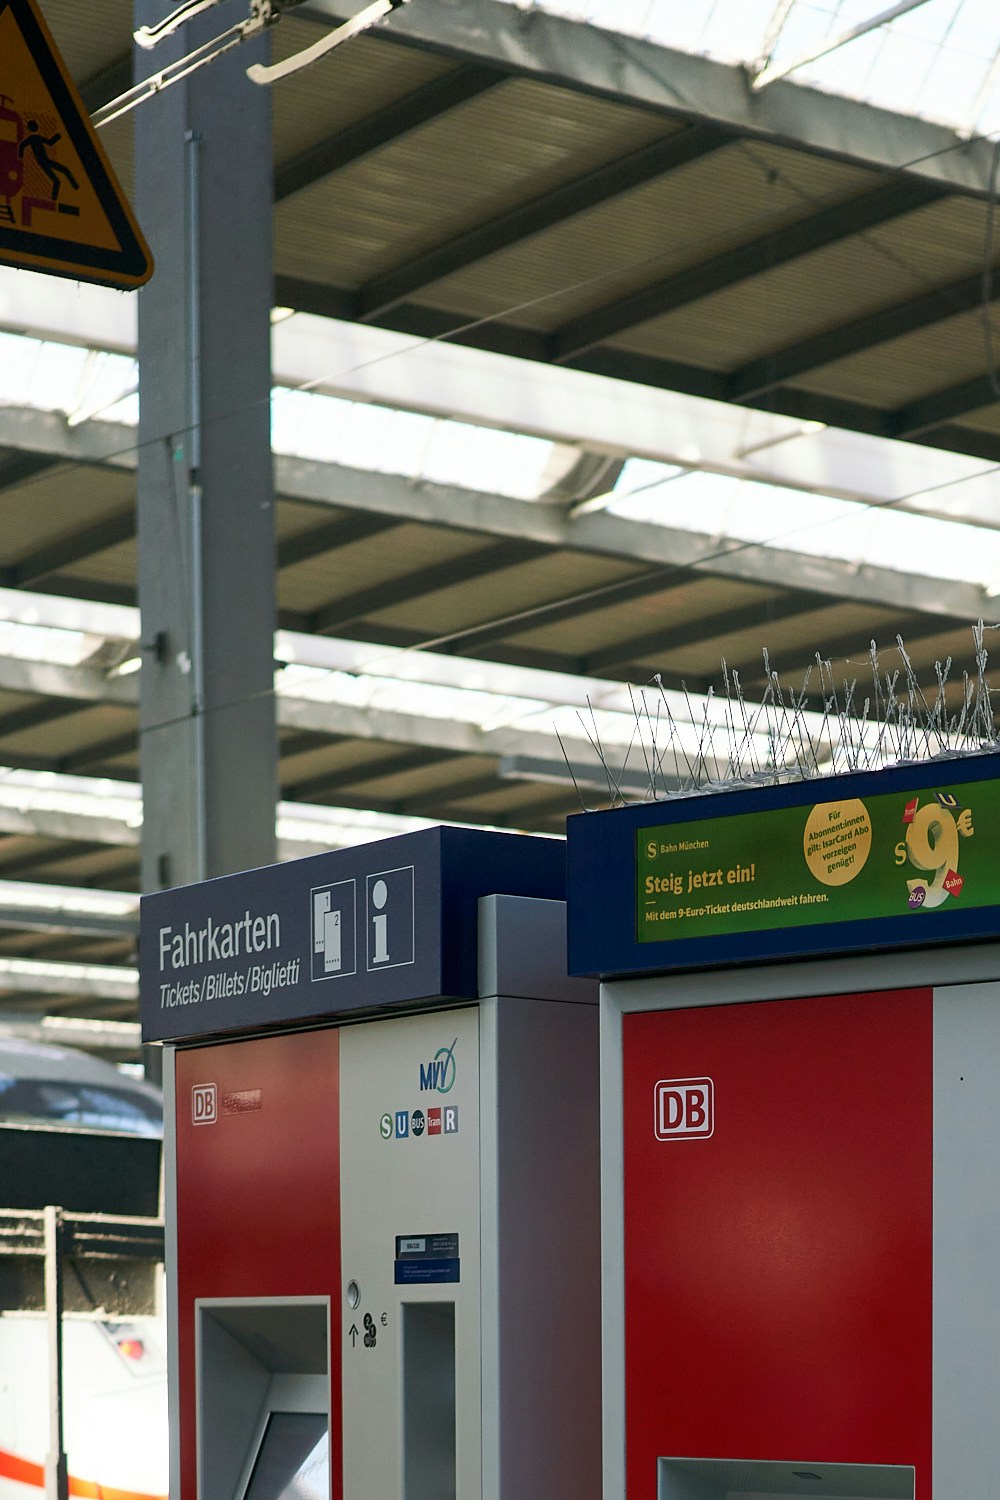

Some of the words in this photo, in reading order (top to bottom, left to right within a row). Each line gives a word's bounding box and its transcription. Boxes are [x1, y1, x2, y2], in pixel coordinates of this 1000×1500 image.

[938, 792, 957, 807] U
[808, 813, 866, 842] Abonnent:innen
[828, 810, 842, 822] Für
[647, 842, 657, 859] S
[660, 843, 678, 854] Bahn
[678, 839, 709, 852] München
[807, 842, 822, 857] gilt:
[822, 832, 853, 851] IsarCard
[854, 825, 869, 839] Abo
[822, 842, 858, 862] vorzeigen
[894, 841, 908, 866] S
[827, 854, 855, 874] genügt!
[905, 802, 959, 909] 9
[956, 808, 975, 837] €
[645, 872, 684, 895] Steig
[688, 868, 724, 893] jetzt
[726, 863, 756, 885] ein!
[945, 876, 963, 889] Bahn
[645, 911, 659, 922] Mit
[660, 909, 677, 920] dem
[678, 904, 731, 919] 9-Euro-Ticket
[731, 895, 798, 912] deutschlandweit
[799, 892, 829, 905] fahren.
[908, 891, 925, 903] BUS
[334, 914, 339, 927] 2
[159, 911, 280, 971] Fahrkarten
[159, 958, 300, 1009] Tickets/Billets/Biglietti
[194, 1088, 215, 1120] DB
[660, 1084, 709, 1134] DB
[381, 1115, 391, 1138] S
[397, 1115, 406, 1135] U
[411, 1117, 424, 1129] BUS
[427, 1116, 441, 1127] Tram
[446, 1109, 455, 1131] R
[380, 1312, 388, 1327] €
